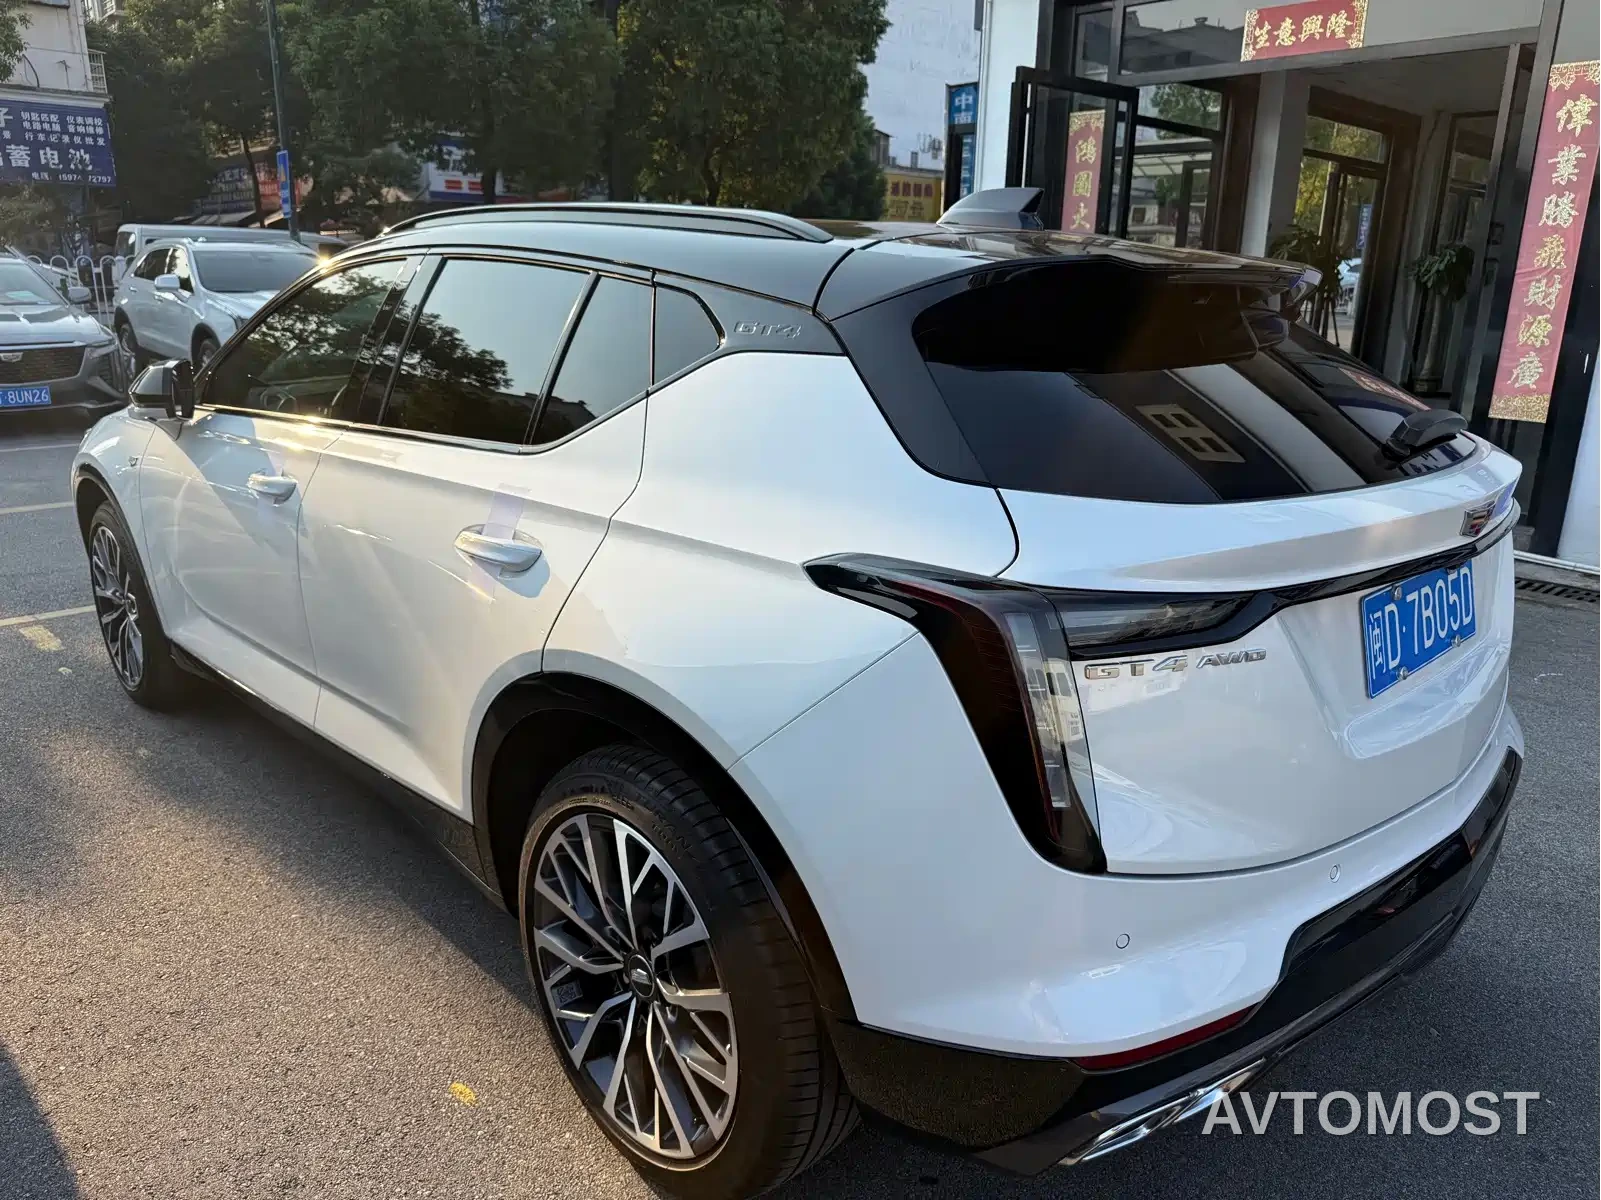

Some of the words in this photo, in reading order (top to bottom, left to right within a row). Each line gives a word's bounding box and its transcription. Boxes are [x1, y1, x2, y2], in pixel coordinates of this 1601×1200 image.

[1254, 10, 1353, 49] 生意興隆
[0, 144, 93, 171] 蓄电池
[734, 320, 802, 340] GT4
[1084, 654, 1189, 680] GT4
[1195, 649, 1267, 669] AWD
